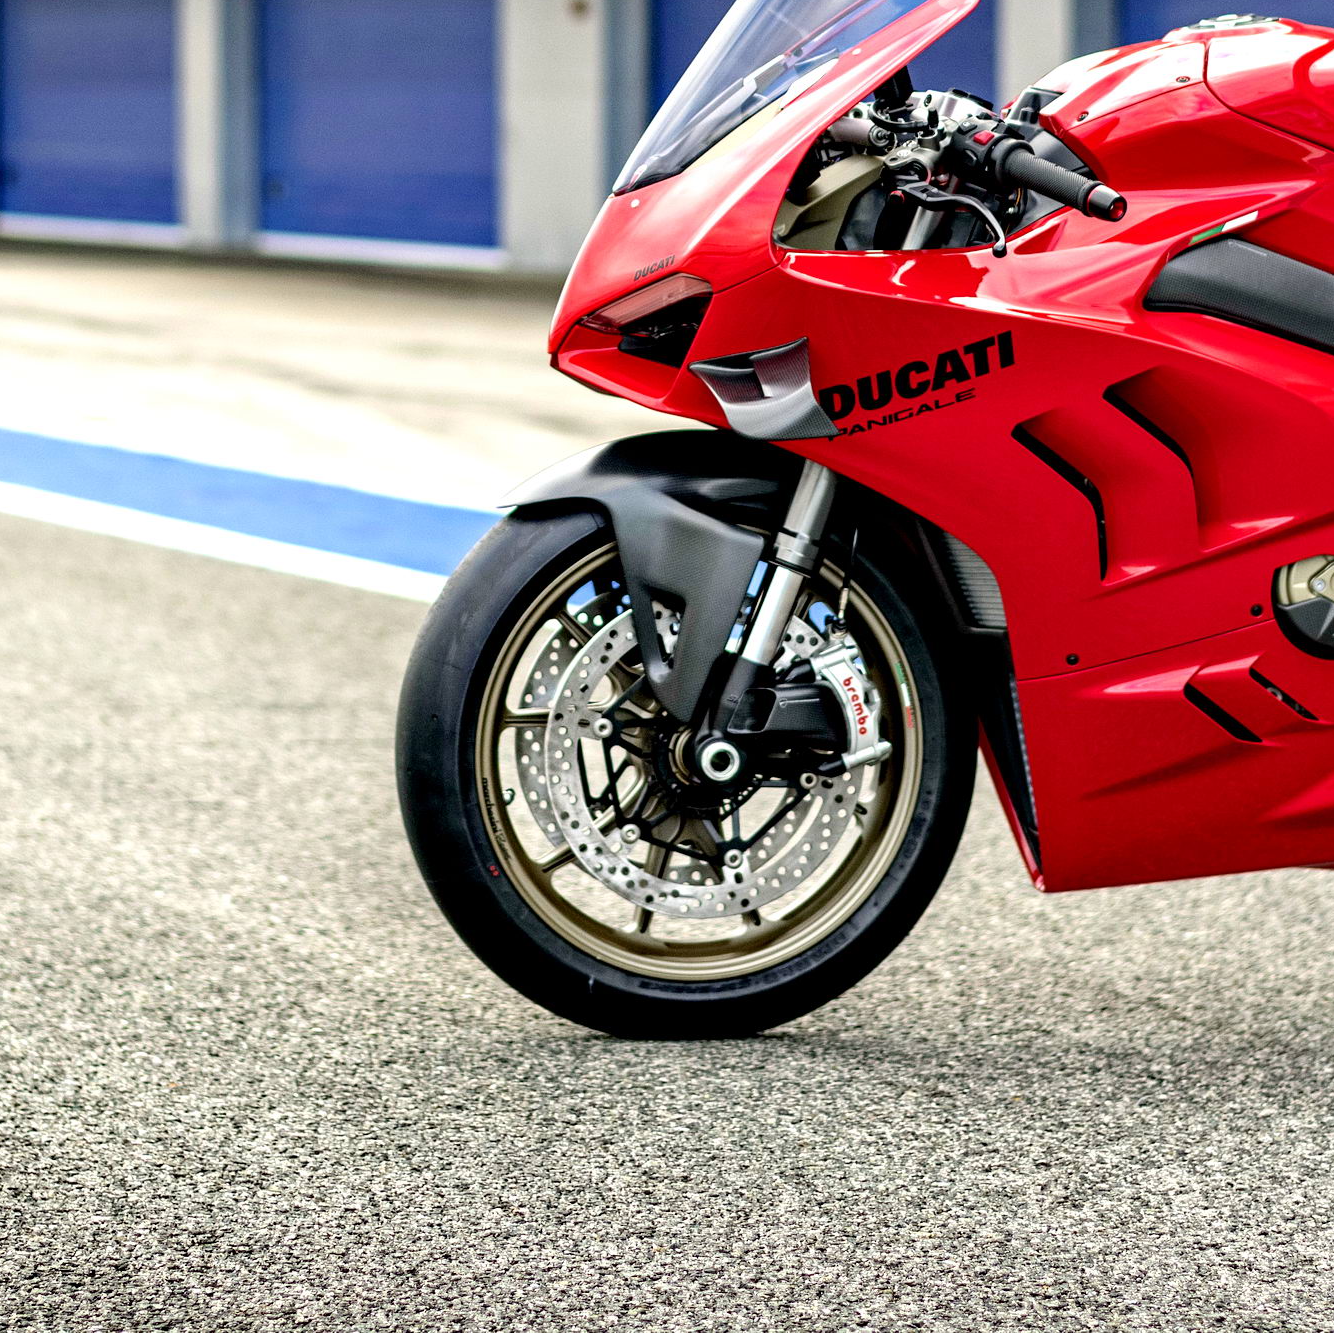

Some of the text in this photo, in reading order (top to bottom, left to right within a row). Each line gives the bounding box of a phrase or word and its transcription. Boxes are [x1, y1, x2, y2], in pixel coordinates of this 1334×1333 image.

[634, 255, 675, 281] DUCATI
[818, 330, 1015, 421] DUCATI
[843, 676, 869, 735] brembo
